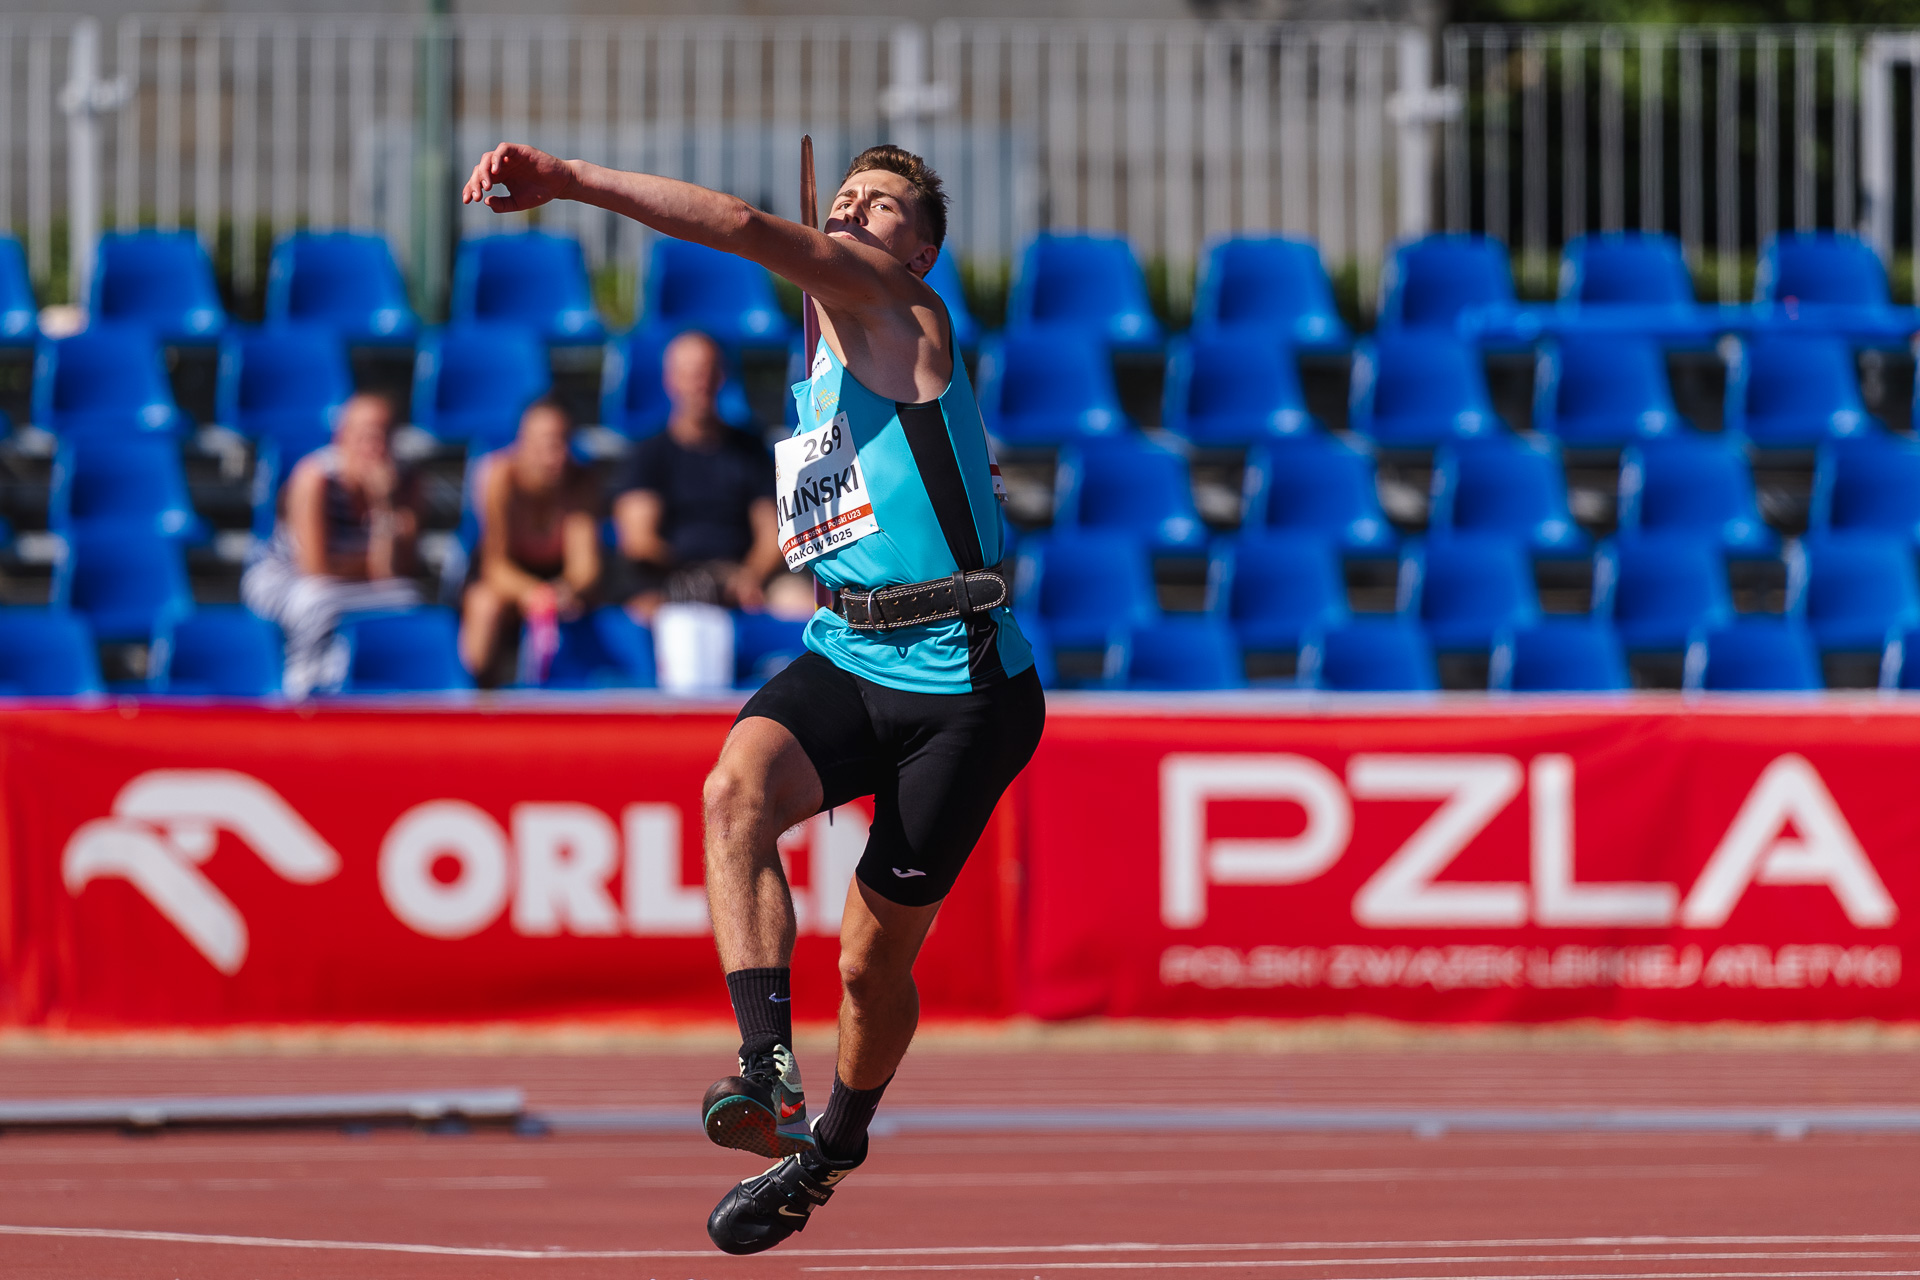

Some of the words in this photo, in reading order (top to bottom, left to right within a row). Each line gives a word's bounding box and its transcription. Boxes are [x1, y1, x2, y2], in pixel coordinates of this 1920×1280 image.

[803, 424, 842, 463] 269
[777, 464, 859, 530] YLIŃSKI
[787, 540, 824, 565] RAKÓW
[826, 528, 853, 547] 2025
[791, 525, 828, 547] Mistrzostwa
[827, 514, 847, 530] Polski
[847, 509, 862, 520] U23
[1158, 752, 1899, 929] PZLA
[1160, 945, 1326, 988] POLSKI
[1704, 945, 1902, 988] ATLETYKI
